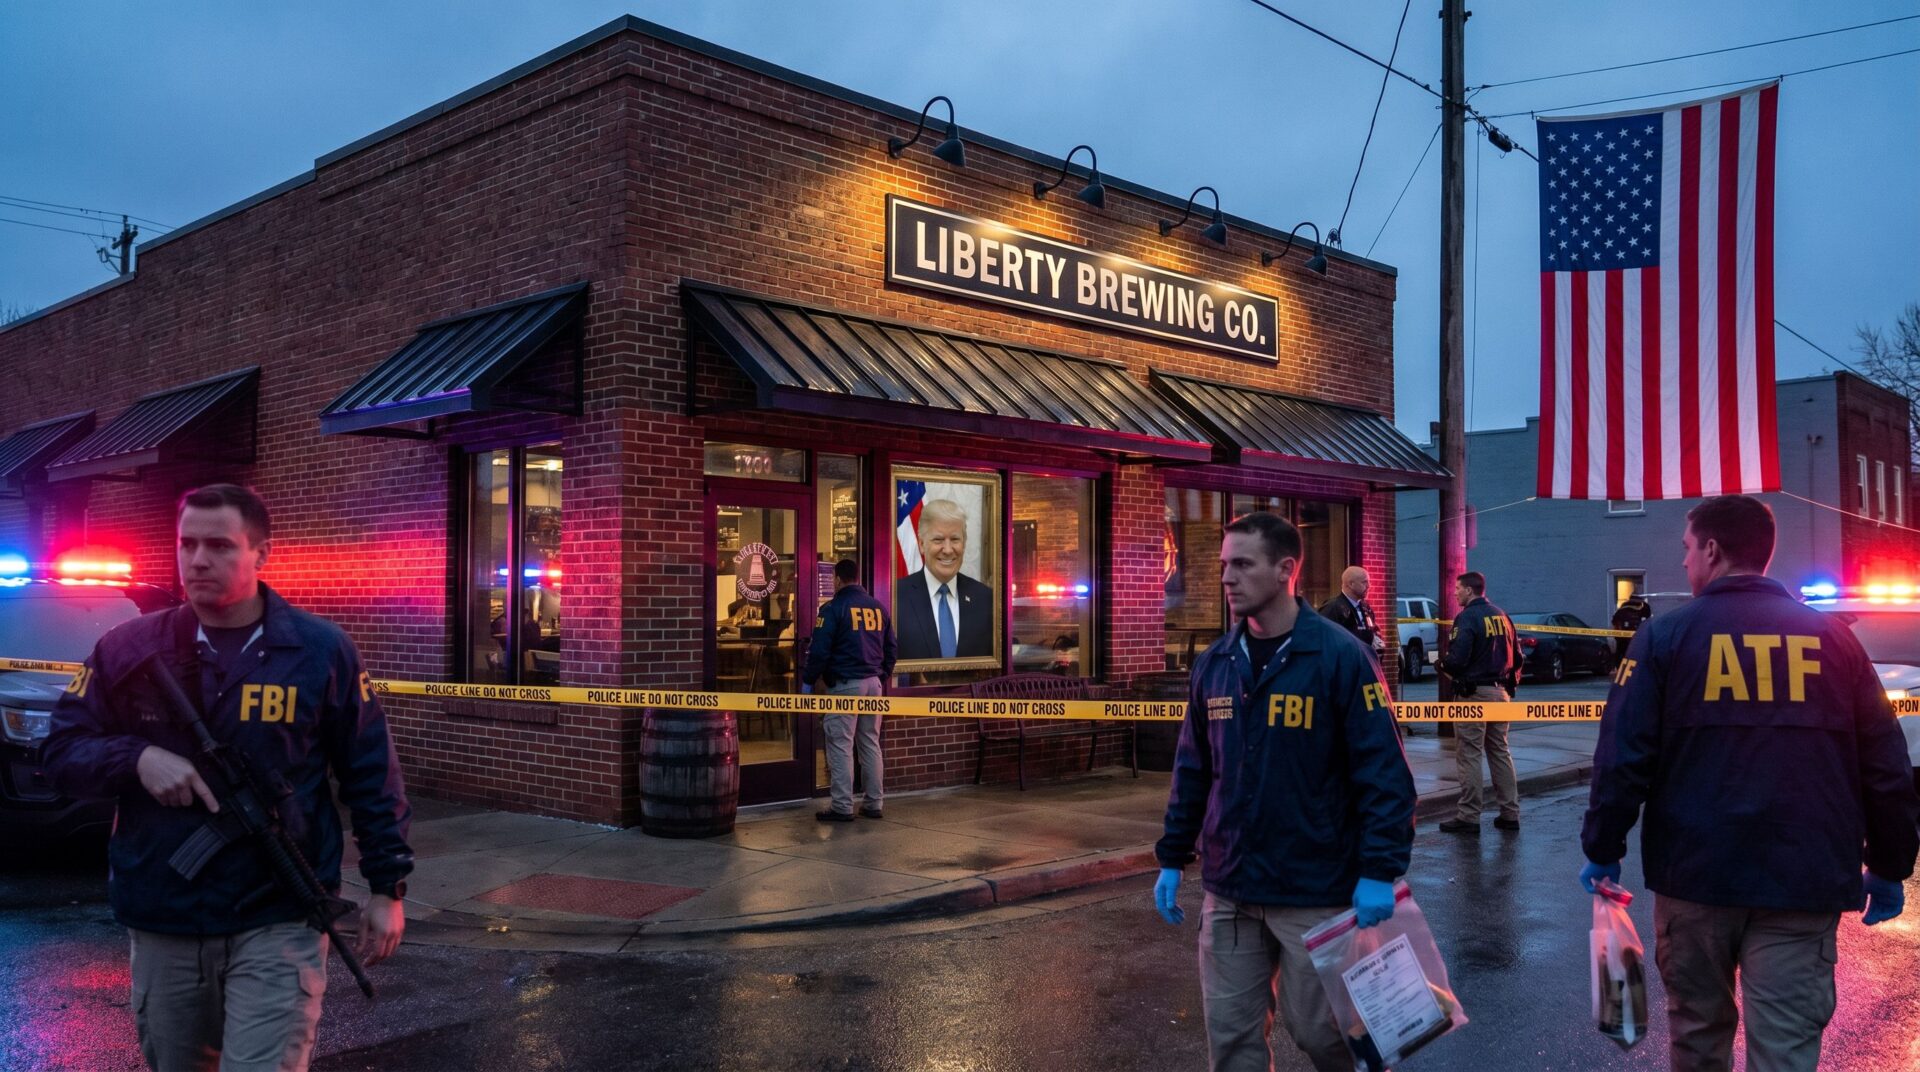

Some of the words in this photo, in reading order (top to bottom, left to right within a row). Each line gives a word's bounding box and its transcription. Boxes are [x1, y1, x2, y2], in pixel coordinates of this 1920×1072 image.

[916, 220, 1066, 299] LIBERTY
[1077, 261, 1215, 334] BREWING
[1224, 299, 1266, 345] CO.
[850, 607, 883, 631] FBI
[1614, 657, 1638, 687] TF
[1703, 633, 1822, 702] ATF
[67, 665, 93, 698] BI
[425, 684, 458, 696] POLICE
[460, 685, 481, 697] LINE
[499, 687, 517, 699] NOT
[519, 689, 552, 700] CROSS
[240, 684, 298, 724] FBI
[587, 690, 622, 703] POLICE
[624, 692, 646, 704] LINE
[648, 693, 662, 705] DO
[664, 694, 684, 706] NOT
[686, 694, 719, 707] CROSS
[757, 696, 792, 710] POLICE
[794, 697, 817, 710] LINE
[819, 698, 832, 711] DO
[835, 699, 855, 711] NOT
[857, 700, 890, 712] CROSS
[929, 700, 965, 714] POLICE
[967, 701, 989, 714] LINE
[992, 702, 1006, 715] DO
[1009, 702, 1030, 715] NOT
[1032, 703, 1065, 716] CROSS
[1362, 682, 1389, 711] FB
[1104, 703, 1141, 716] POLICE
[1143, 704, 1166, 717] LINE
[1169, 705, 1183, 717] DO
[1267, 693, 1314, 730] FBI
[1406, 705, 1421, 719] DO
[1424, 705, 1445, 719] NOT
[1449, 705, 1483, 719] CROSS
[1527, 705, 1565, 718] POLICE
[1568, 704, 1594, 718] LINE
[1596, 704, 1605, 718] D
